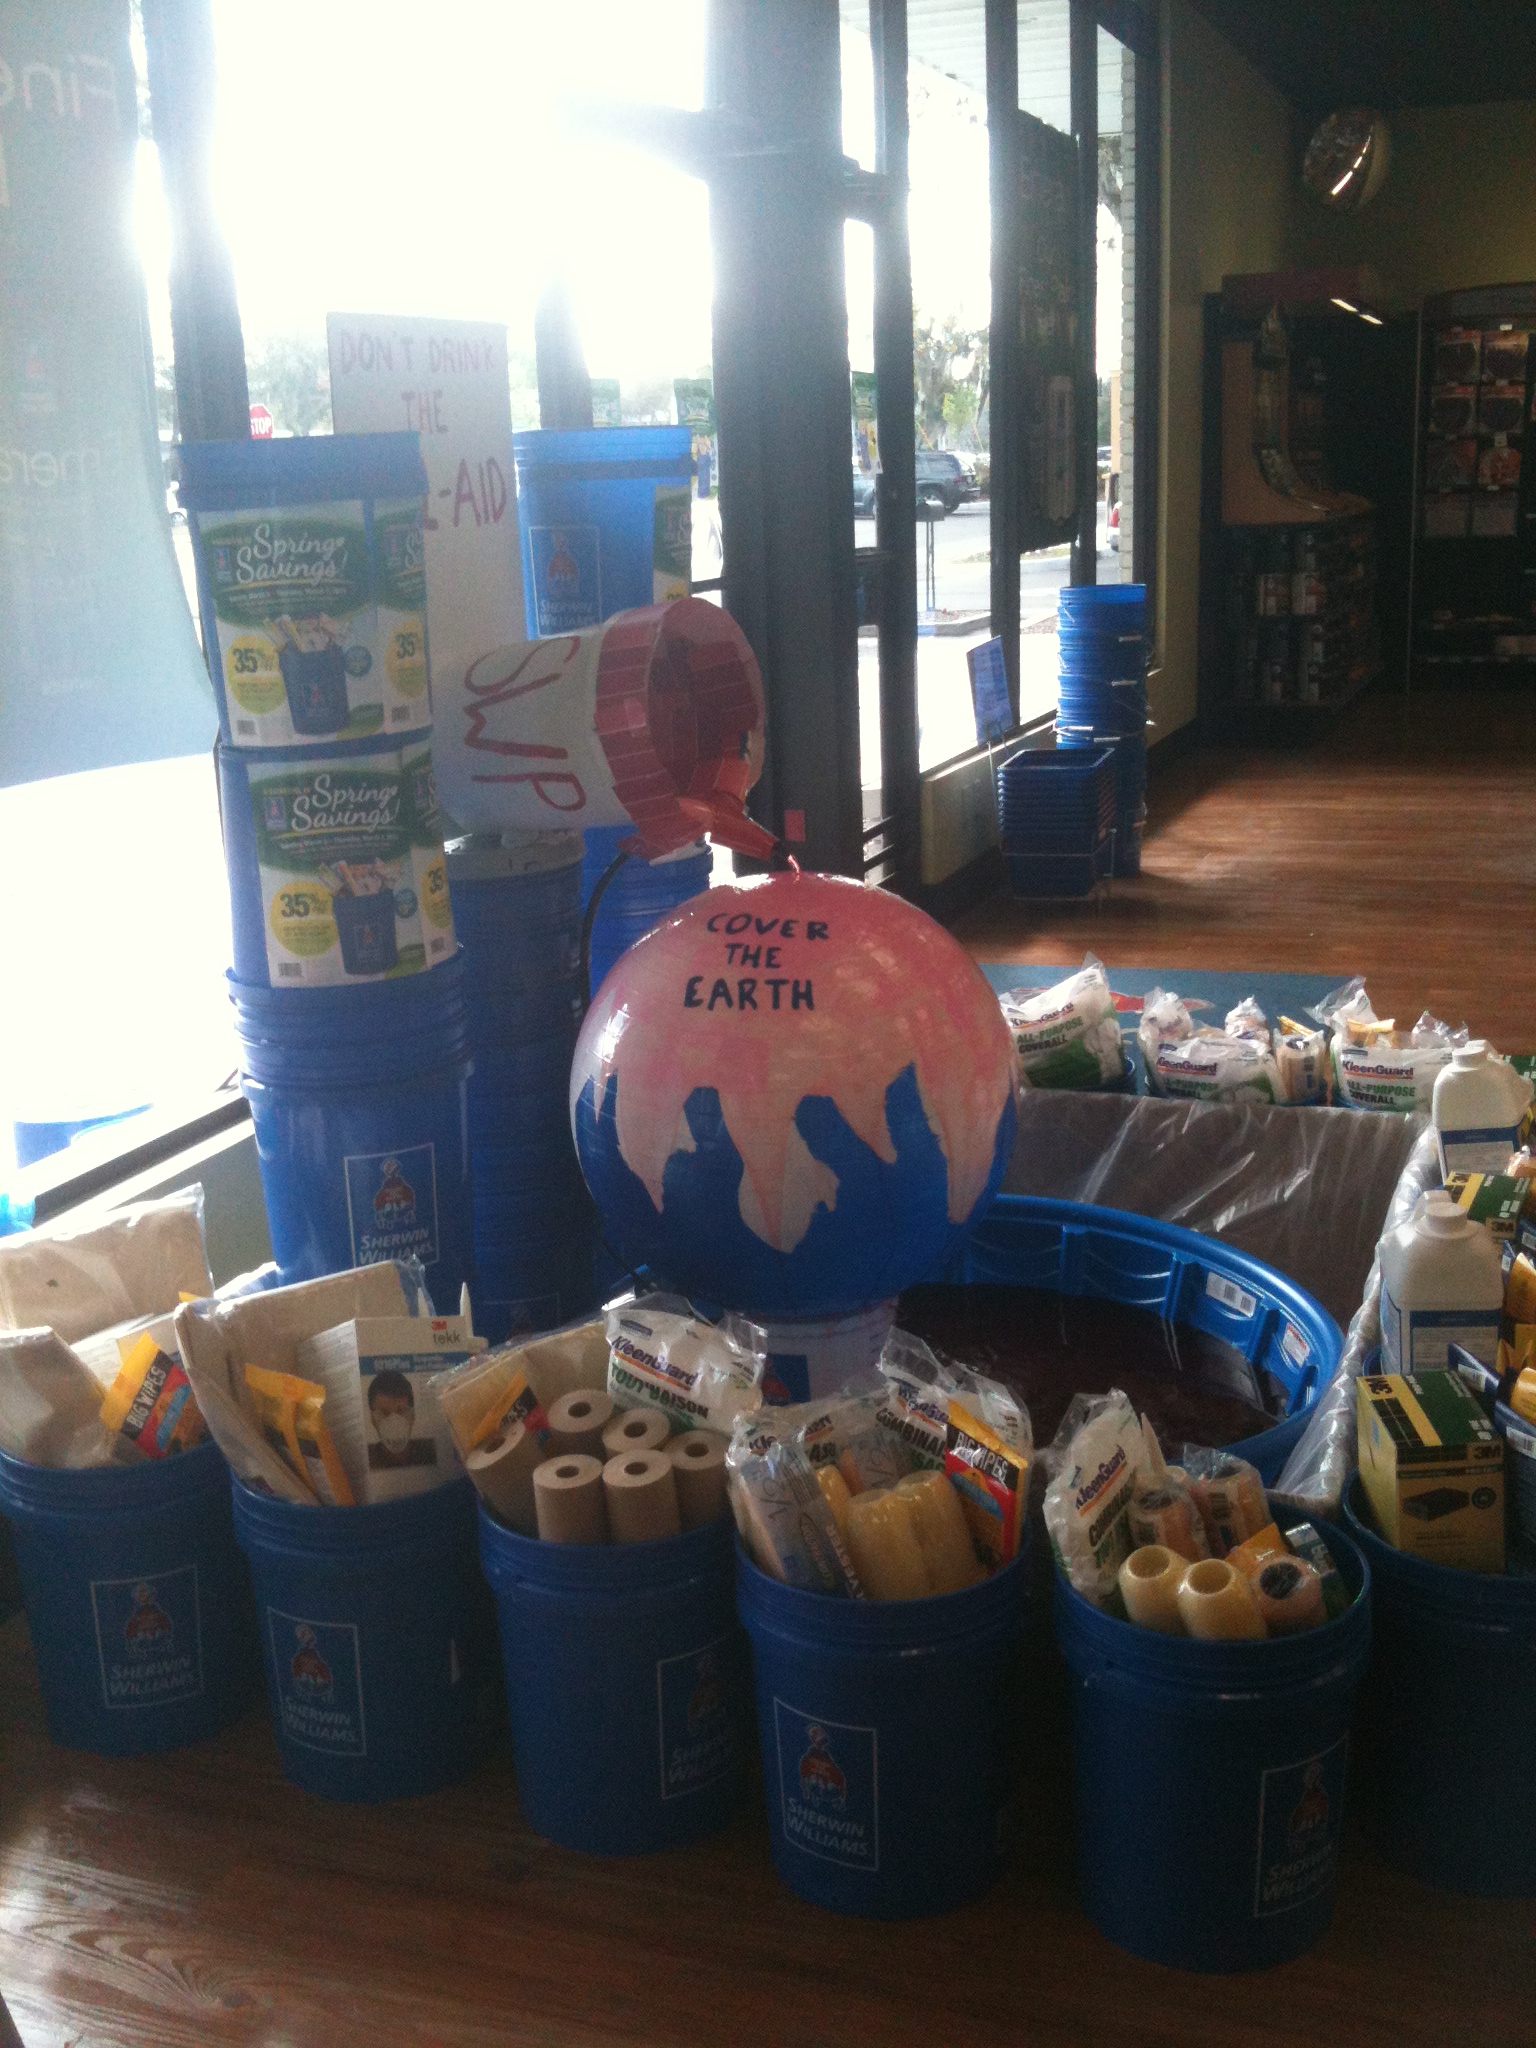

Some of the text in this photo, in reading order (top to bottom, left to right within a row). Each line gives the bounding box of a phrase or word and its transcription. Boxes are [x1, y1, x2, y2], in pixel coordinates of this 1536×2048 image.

[340, 328, 414, 374] DON'T
[401, 388, 449, 434] THE
[254, 524, 339, 562] Spring
[463, 636, 587, 812] SWP
[312, 773, 395, 812] Spring
[707, 913, 829, 941] COVER
[725, 943, 782, 969] THE
[683, 975, 815, 1011] EARTH
[1342, 1060, 1415, 1077] KleenGuard
[361, 1227, 429, 1250] SHERWIN
[432, 1331, 461, 1345] tekk
[126, 1364, 168, 1429] BIG WIPES
[787, 1797, 865, 1838] SHERWIN
